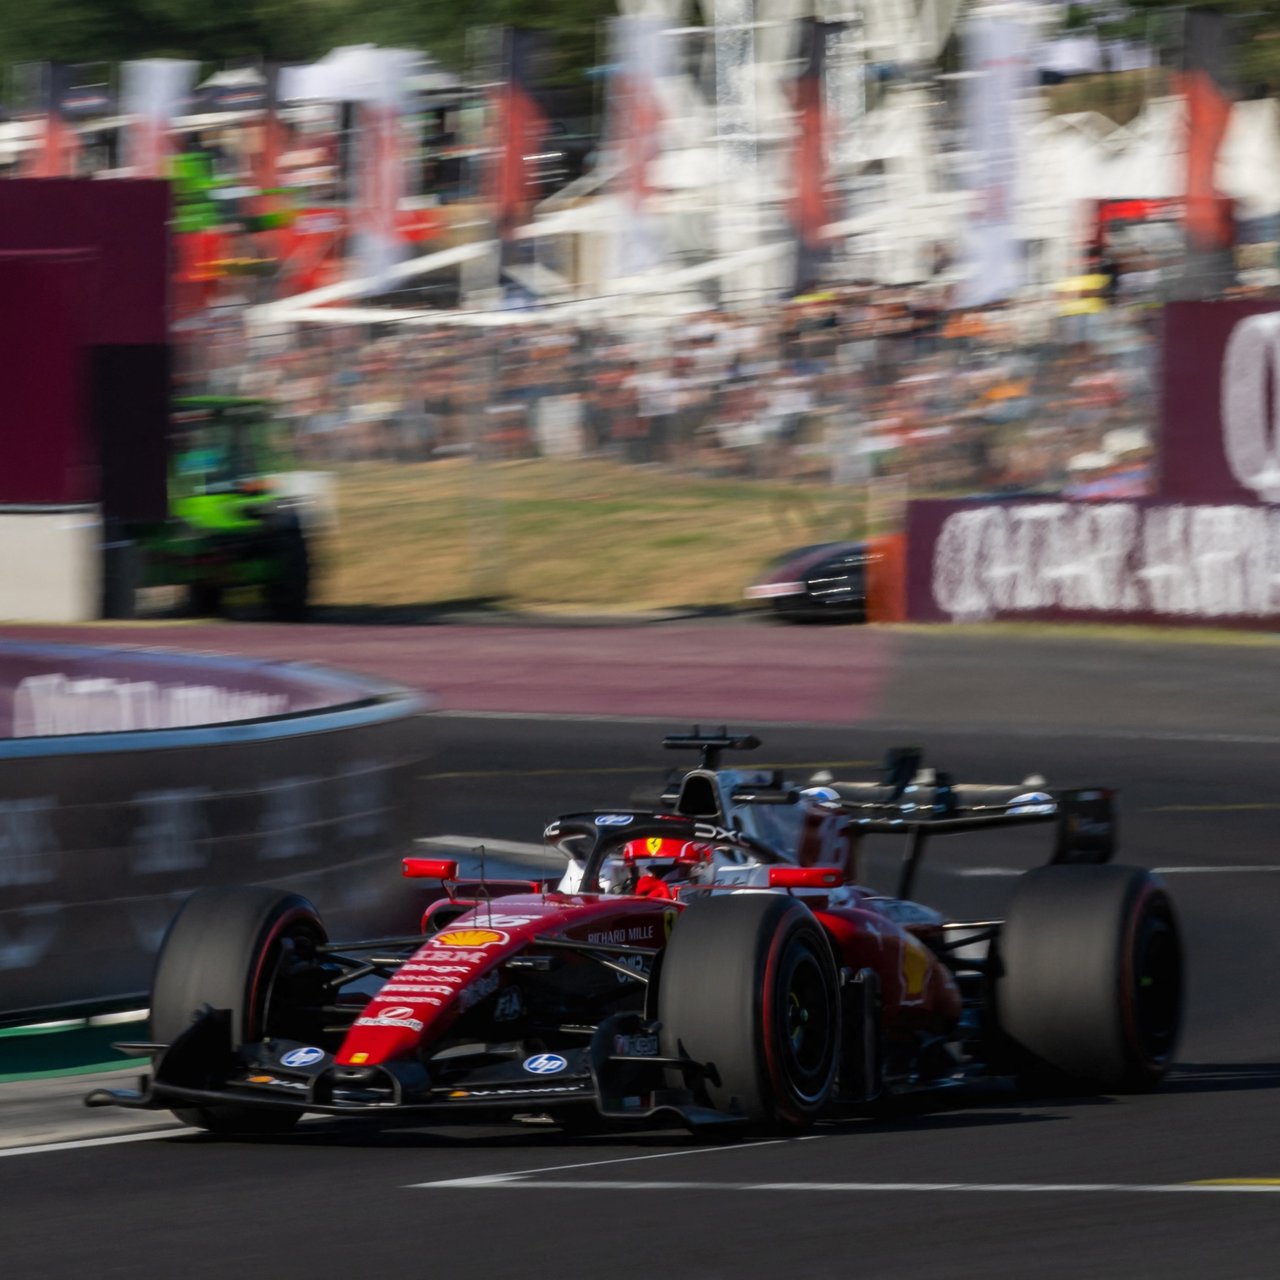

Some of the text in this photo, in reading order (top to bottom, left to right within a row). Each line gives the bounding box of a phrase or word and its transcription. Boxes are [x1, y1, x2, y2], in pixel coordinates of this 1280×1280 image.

[587, 925, 656, 945] RICHARD MILLE
[412, 950, 488, 964] IBM
